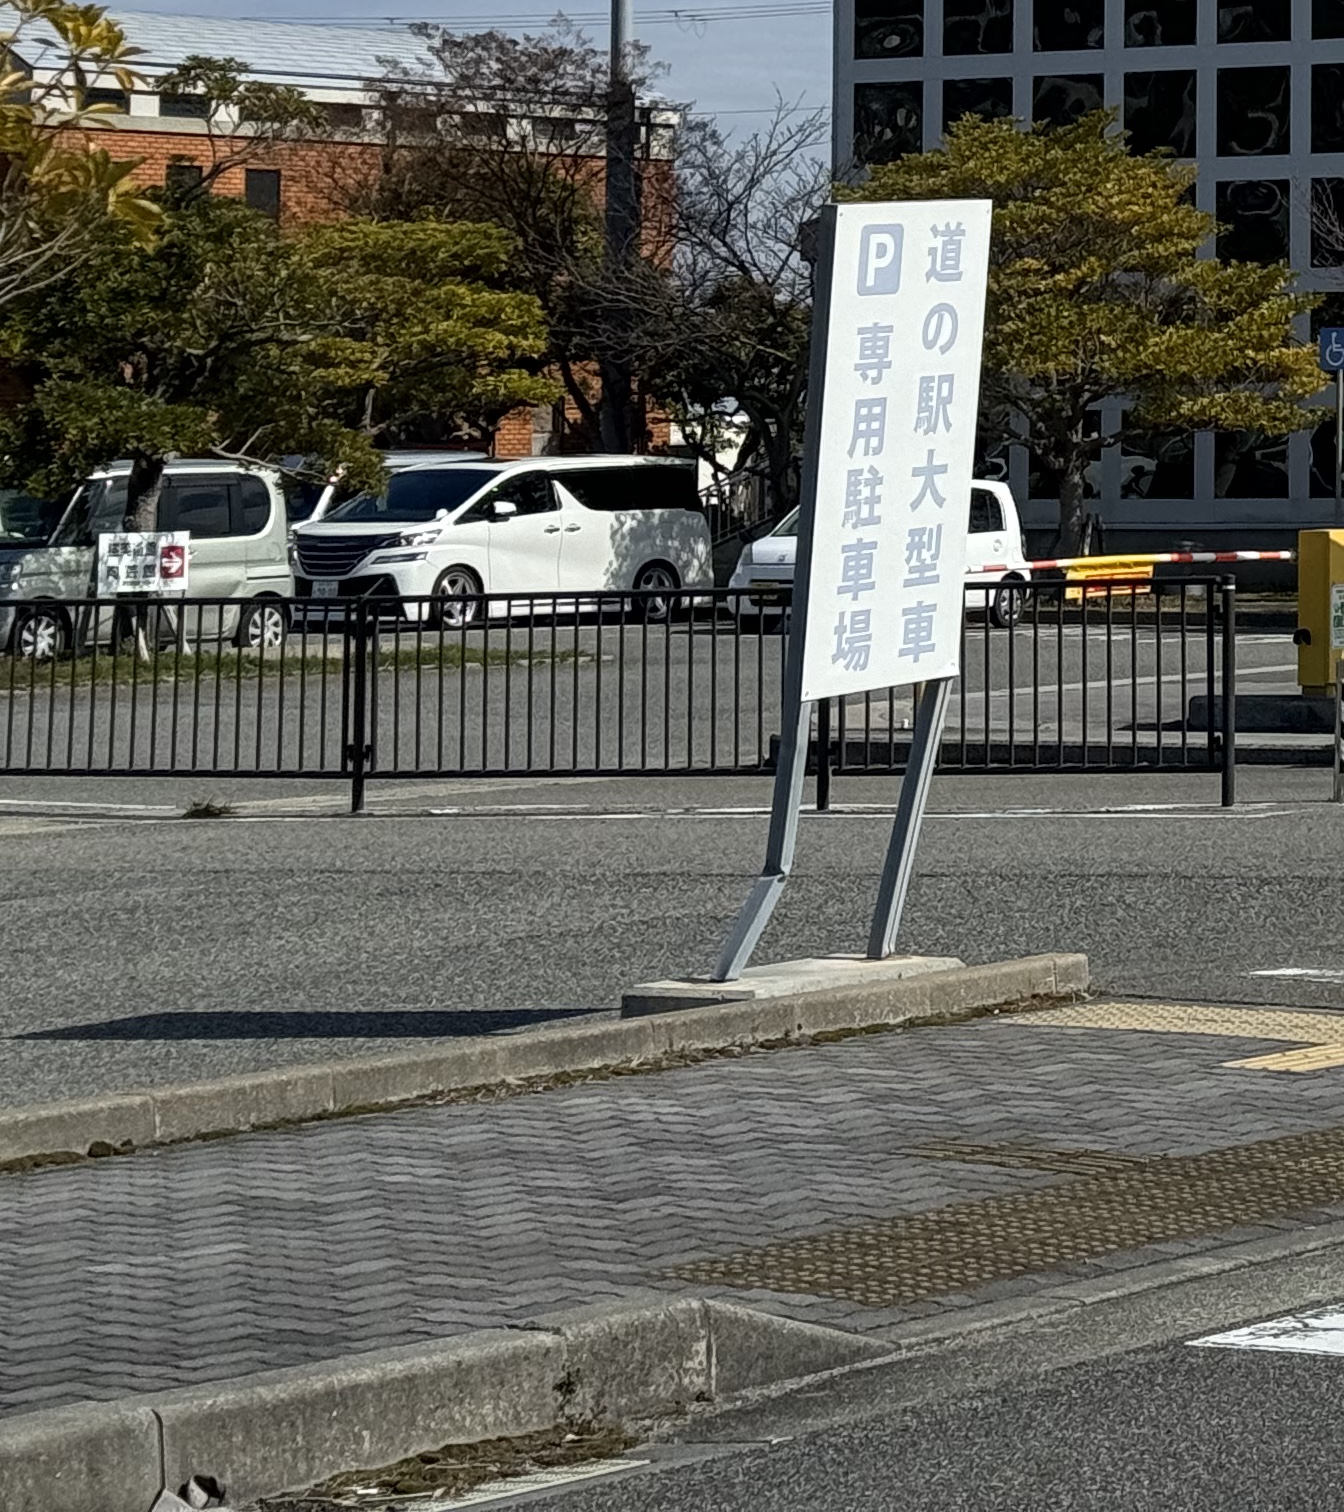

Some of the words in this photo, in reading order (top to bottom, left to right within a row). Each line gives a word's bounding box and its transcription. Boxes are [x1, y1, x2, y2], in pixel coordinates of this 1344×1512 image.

[831, 321, 894, 671] 専用駐車場
[897, 221, 967, 664] 道の駅大型車
